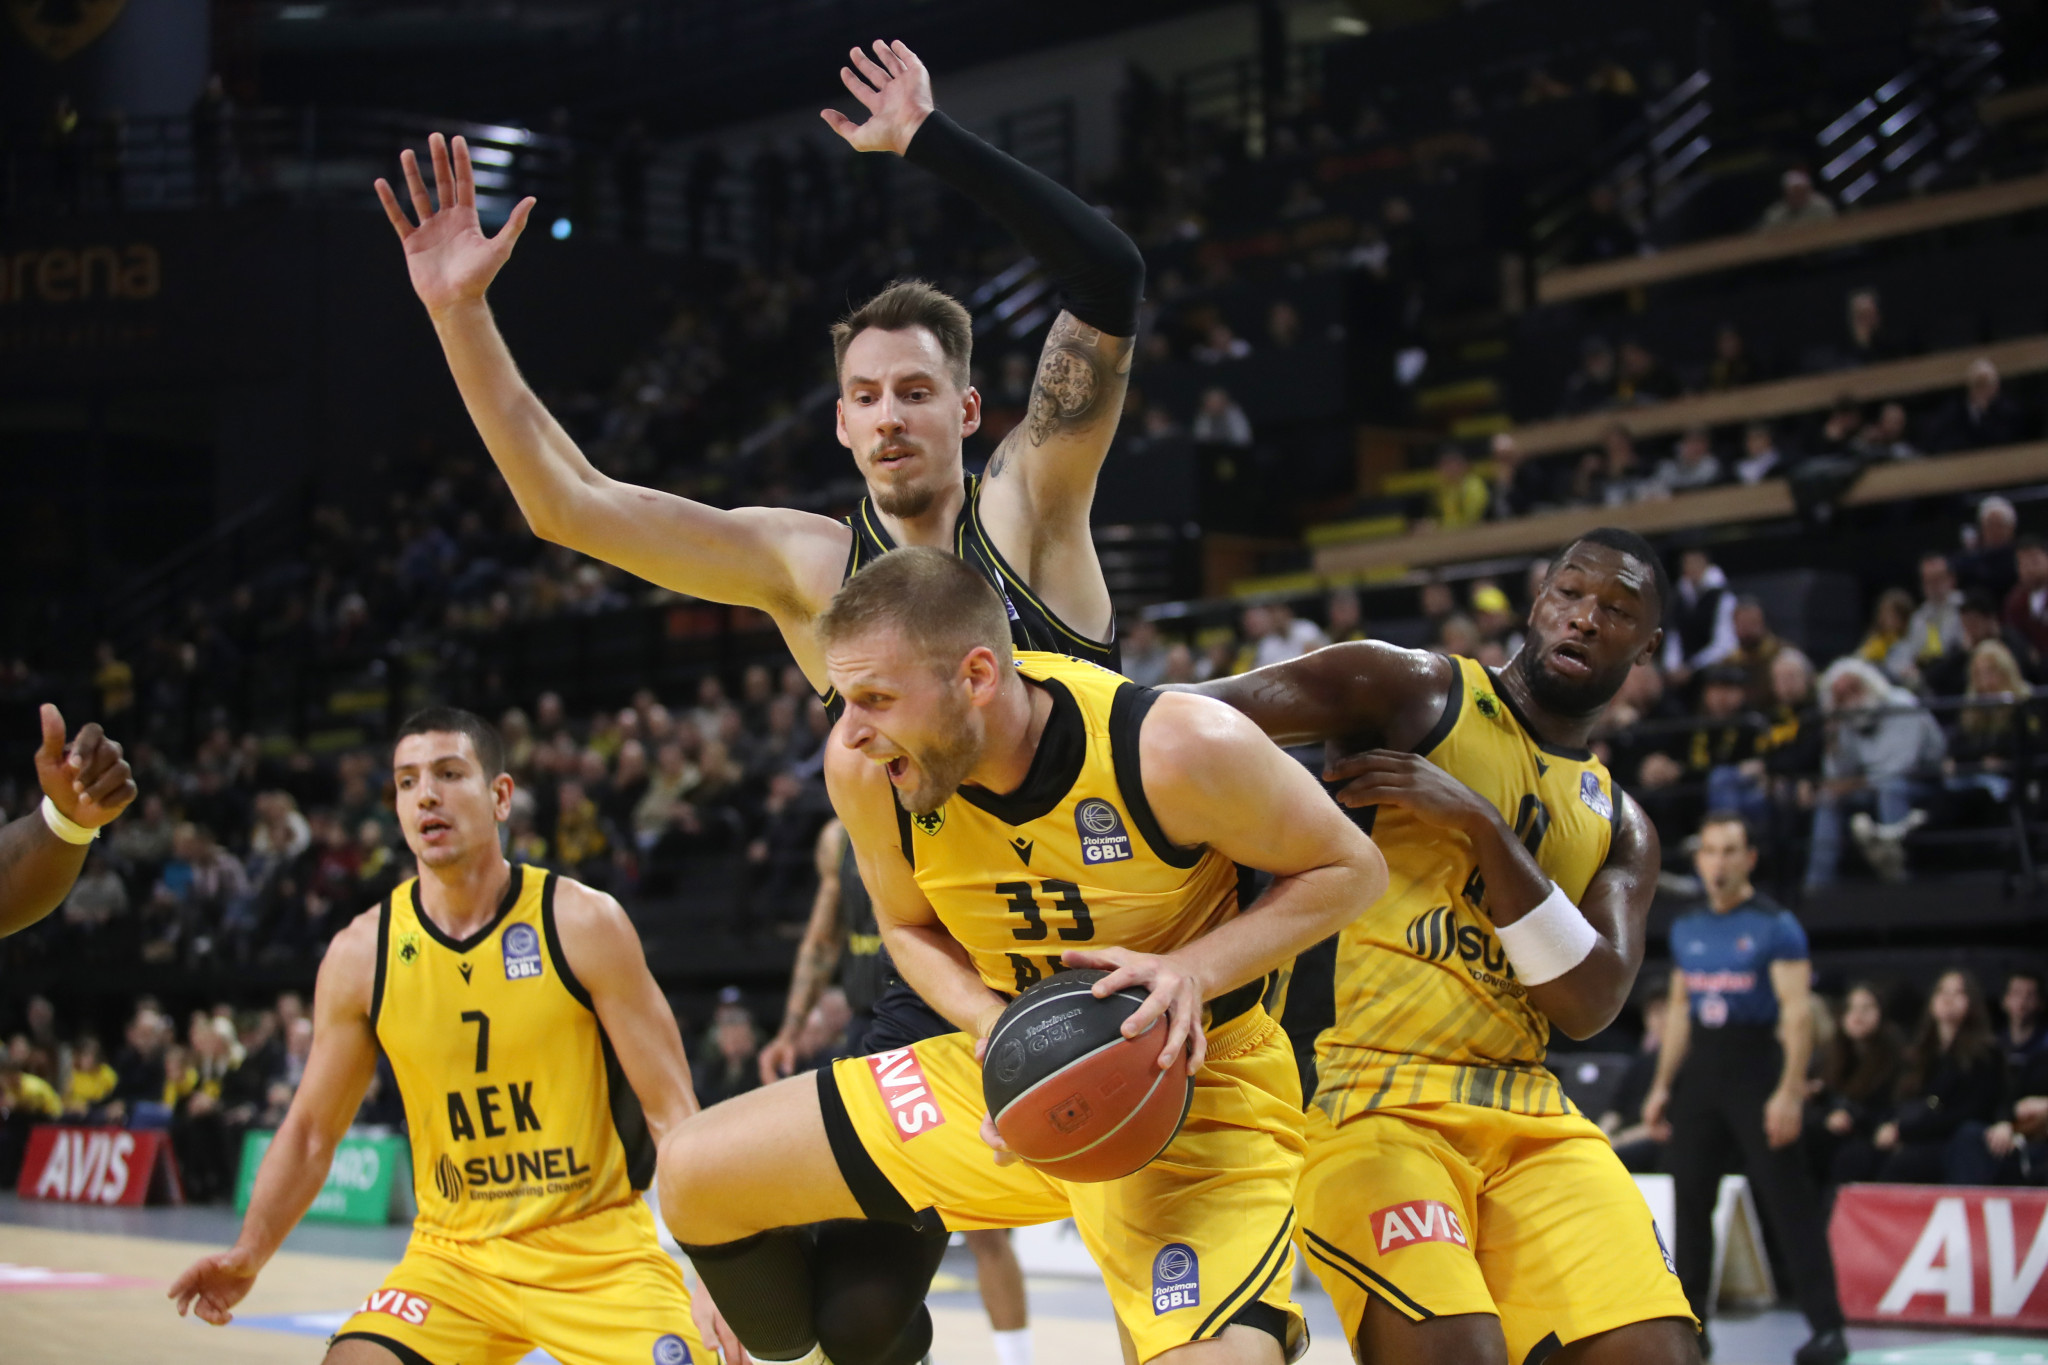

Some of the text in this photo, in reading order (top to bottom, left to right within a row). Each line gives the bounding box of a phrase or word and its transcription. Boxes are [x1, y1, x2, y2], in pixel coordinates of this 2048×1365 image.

[0, 242, 163, 304] rena
[1082, 835, 1127, 846] Stoiximan
[1086, 844, 1129, 861] GBL
[995, 878, 1095, 941] 33
[507, 961, 541, 978] GBL
[461, 1010, 490, 1073] 7
[1029, 1020, 1085, 1056] GBL
[447, 1081, 541, 1141] AEK
[871, 1049, 937, 1133] AVIS
[37, 1129, 135, 1205] AVIS
[464, 1146, 590, 1186] SUNEL
[470, 1185, 544, 1202] Empowering
[1380, 1204, 1466, 1250] AVIS
[1154, 1282, 1197, 1297] Stoiximan
[1156, 1290, 1196, 1311] GBL
